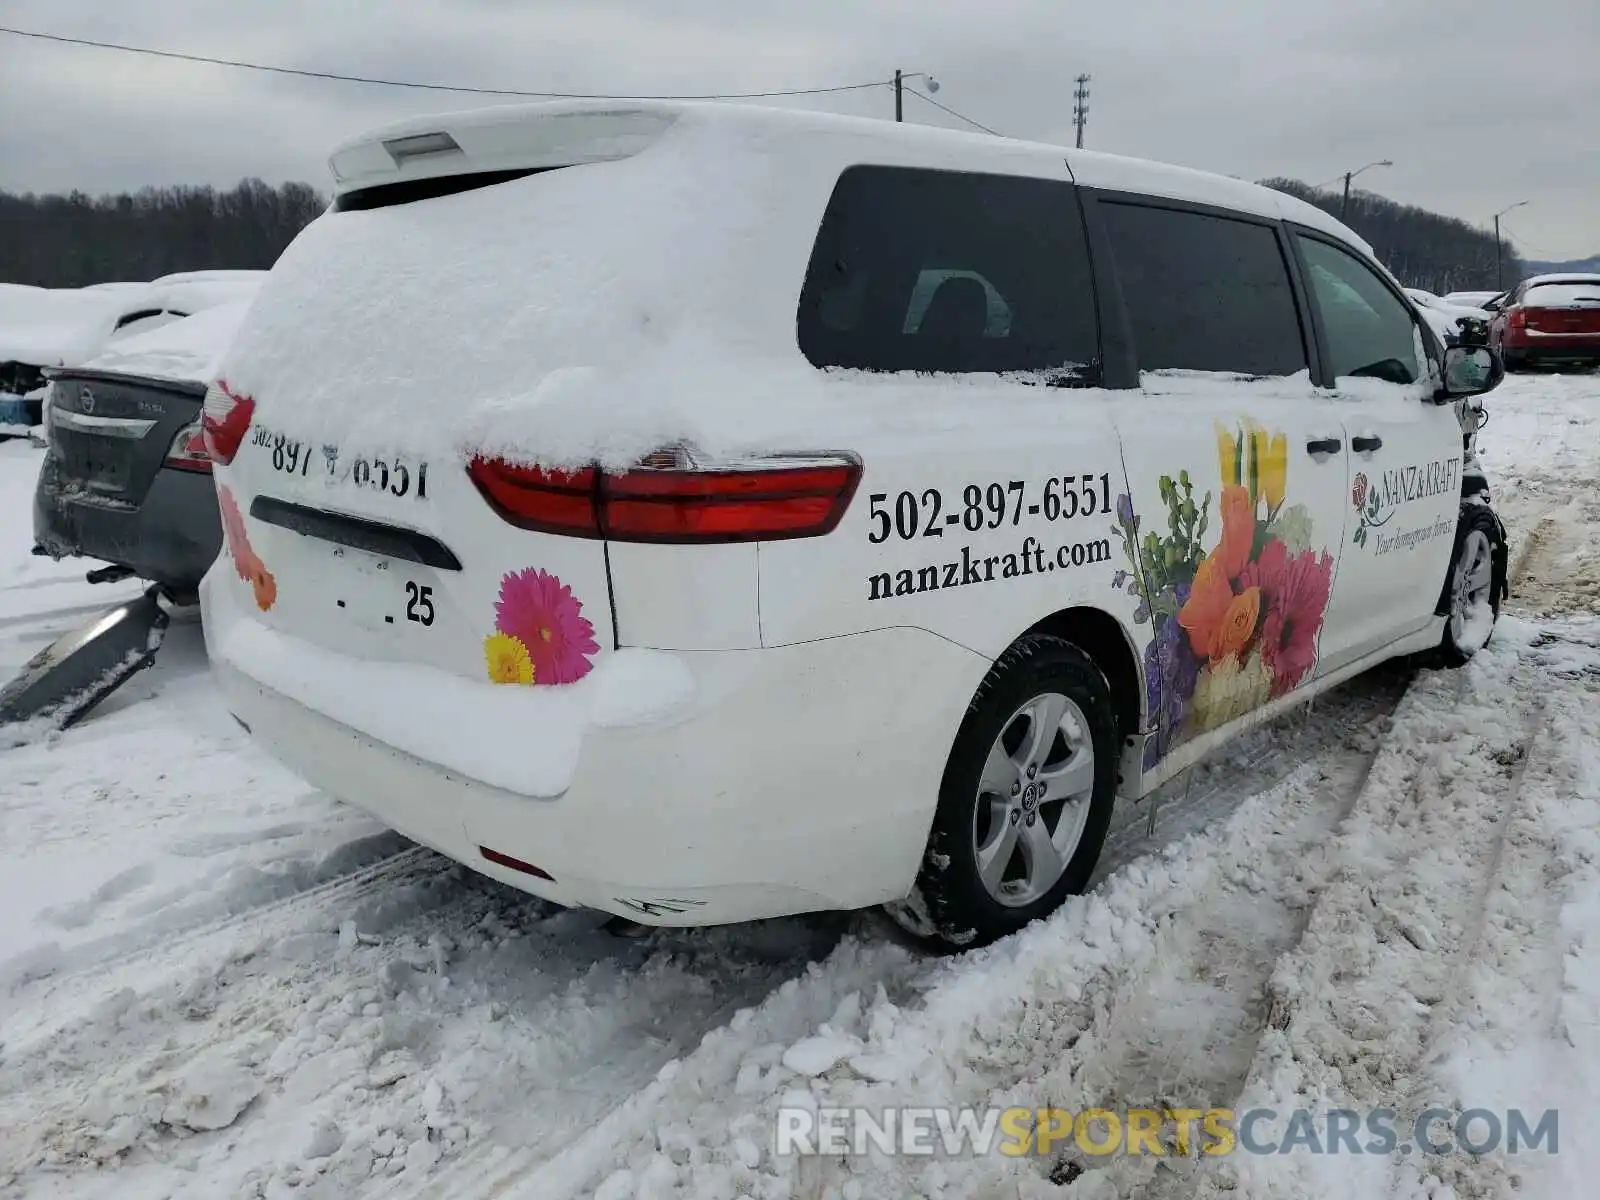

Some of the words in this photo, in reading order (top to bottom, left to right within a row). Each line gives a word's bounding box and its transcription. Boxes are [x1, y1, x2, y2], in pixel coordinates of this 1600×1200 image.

[868, 472, 1112, 544] 502-897-6551
[868, 536, 1112, 601] nanzkraft.com
[405, 580, 434, 627] 25
